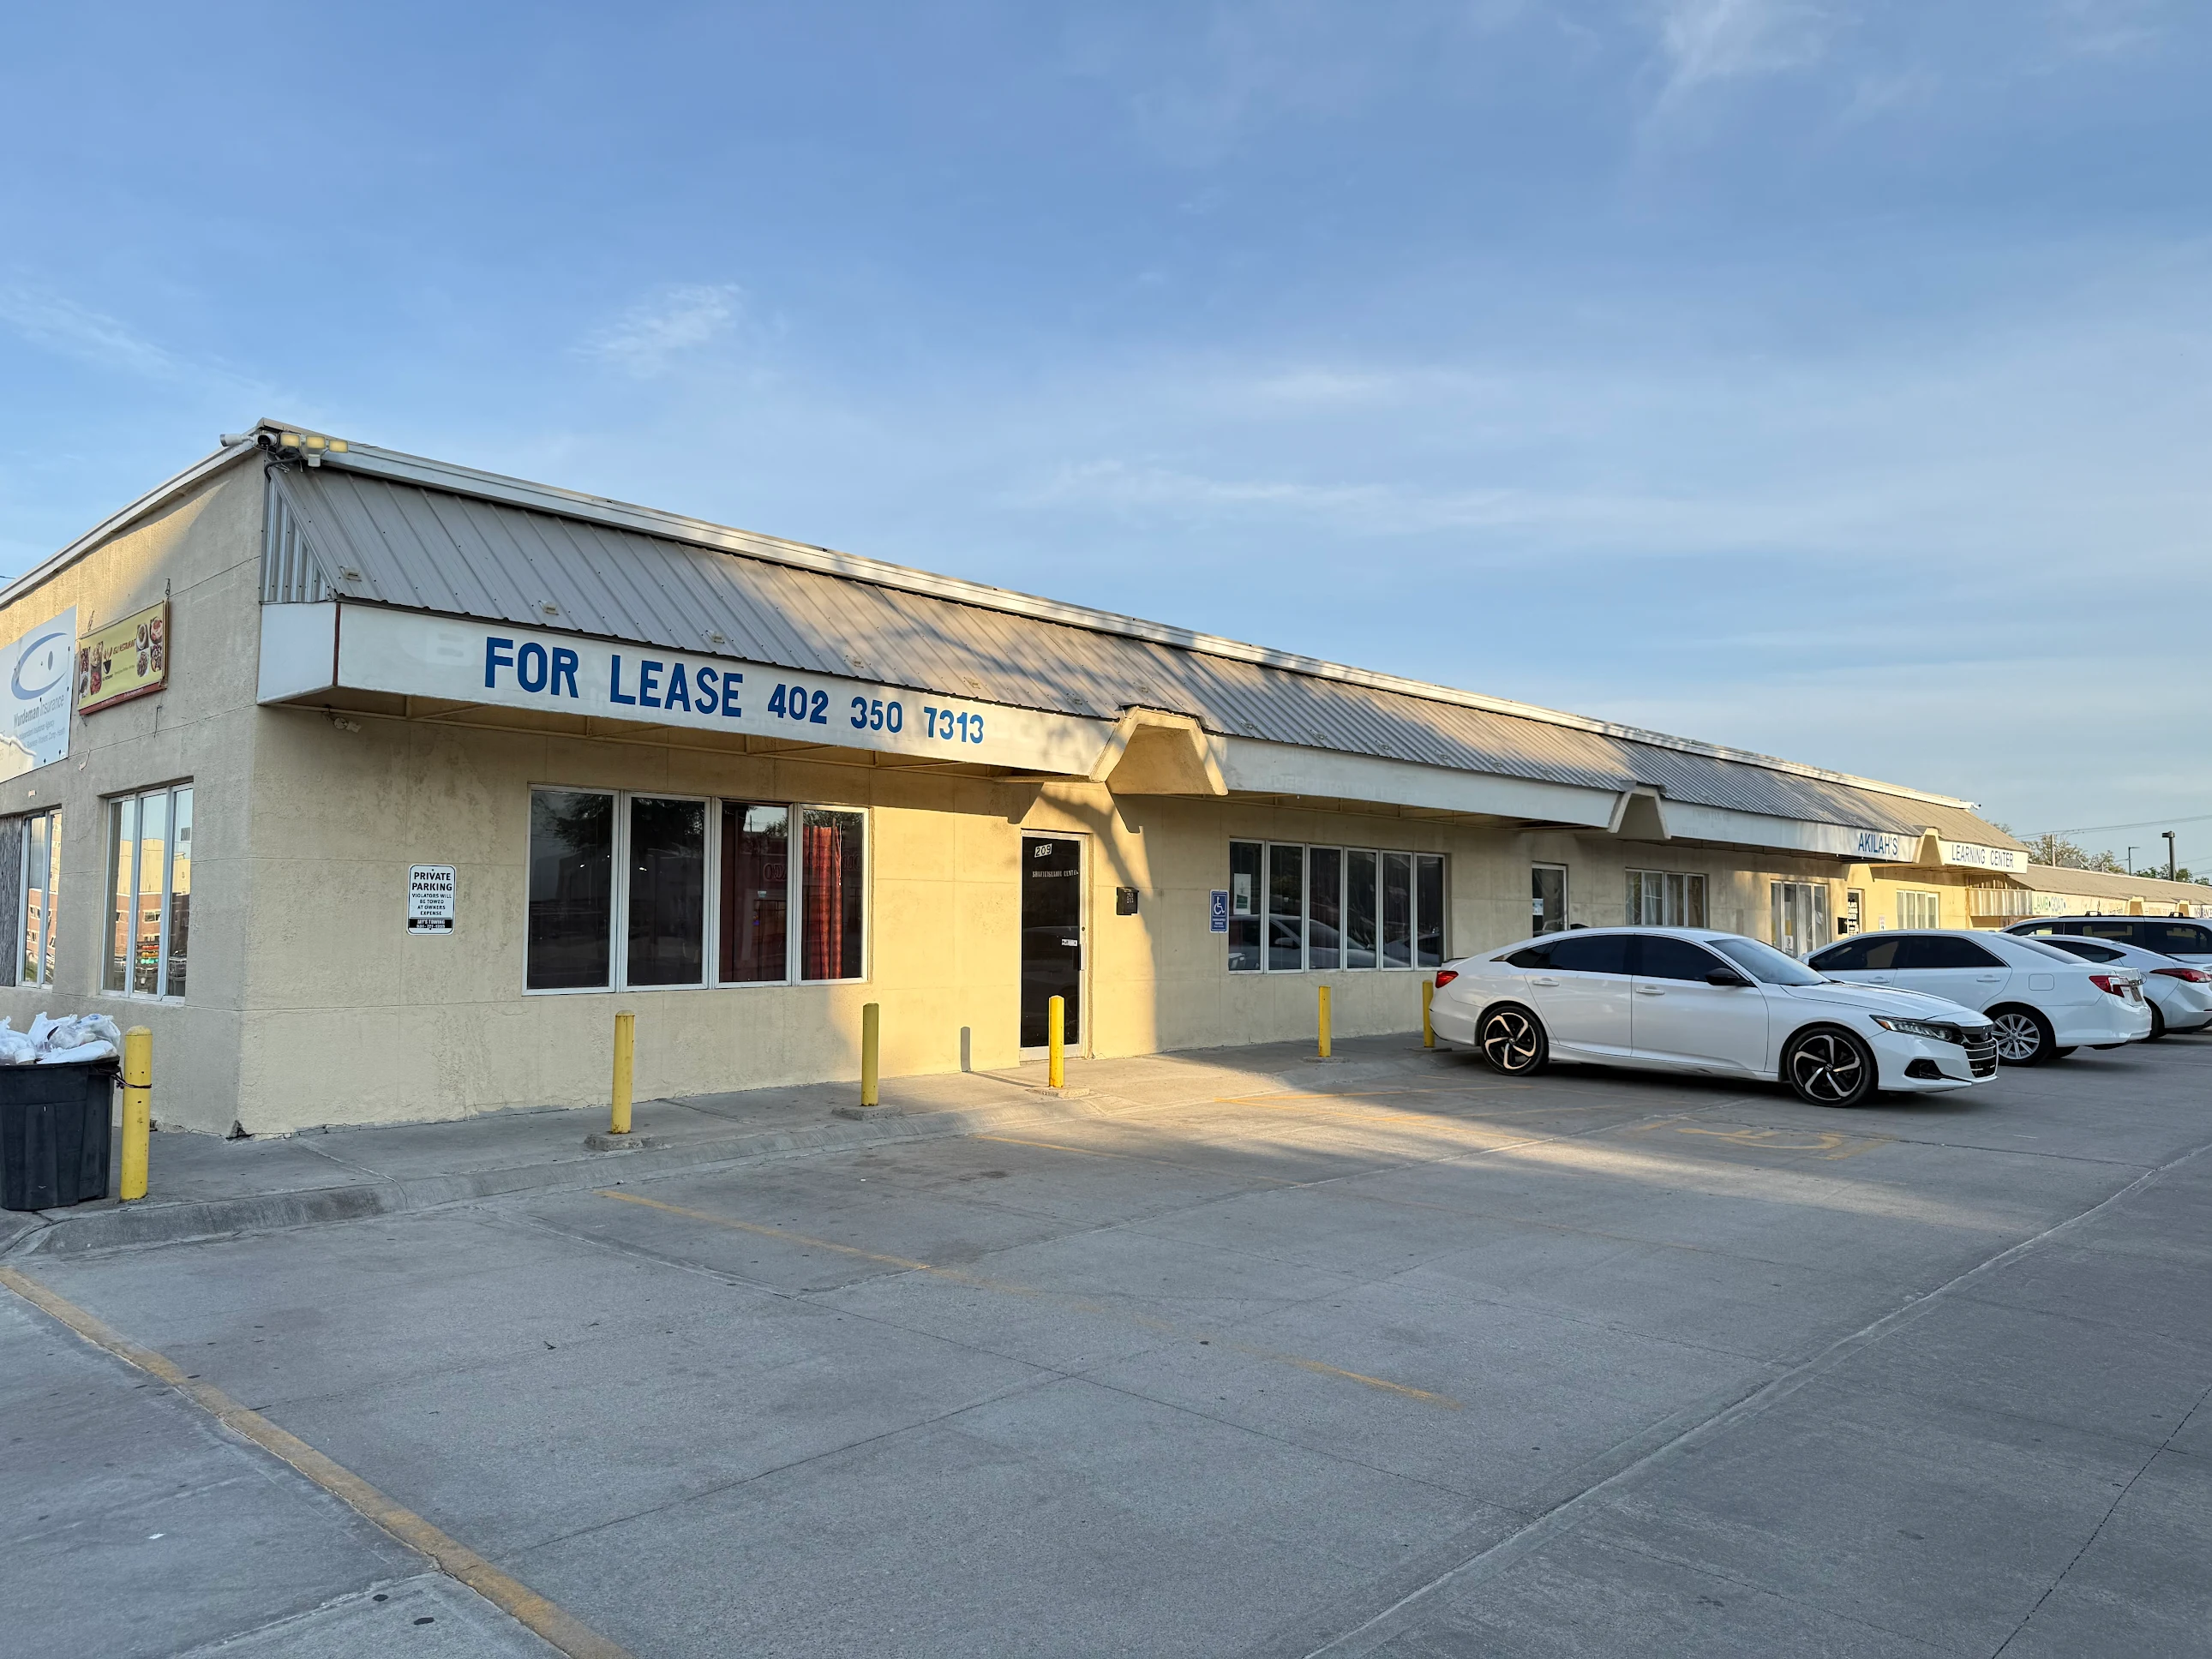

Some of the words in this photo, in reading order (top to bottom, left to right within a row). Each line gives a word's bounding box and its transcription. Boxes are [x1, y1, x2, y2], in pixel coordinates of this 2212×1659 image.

[485, 637, 578, 698] FOR
[610, 655, 743, 717] LEASE
[768, 685, 828, 724] 402
[851, 698, 902, 733] 350
[924, 707, 984, 743] 7313
[14, 707, 39, 729] Wurdeman
[40, 694, 64, 716] Insurance
[1036, 845, 1052, 857] 209
[1858, 832, 1897, 855] AKILAH'S
[1951, 844, 1985, 865] LEARNING
[1990, 850, 2014, 868] CENTER
[411, 883, 453, 891] PARKING
[414, 871, 451, 881] PRIVATE
